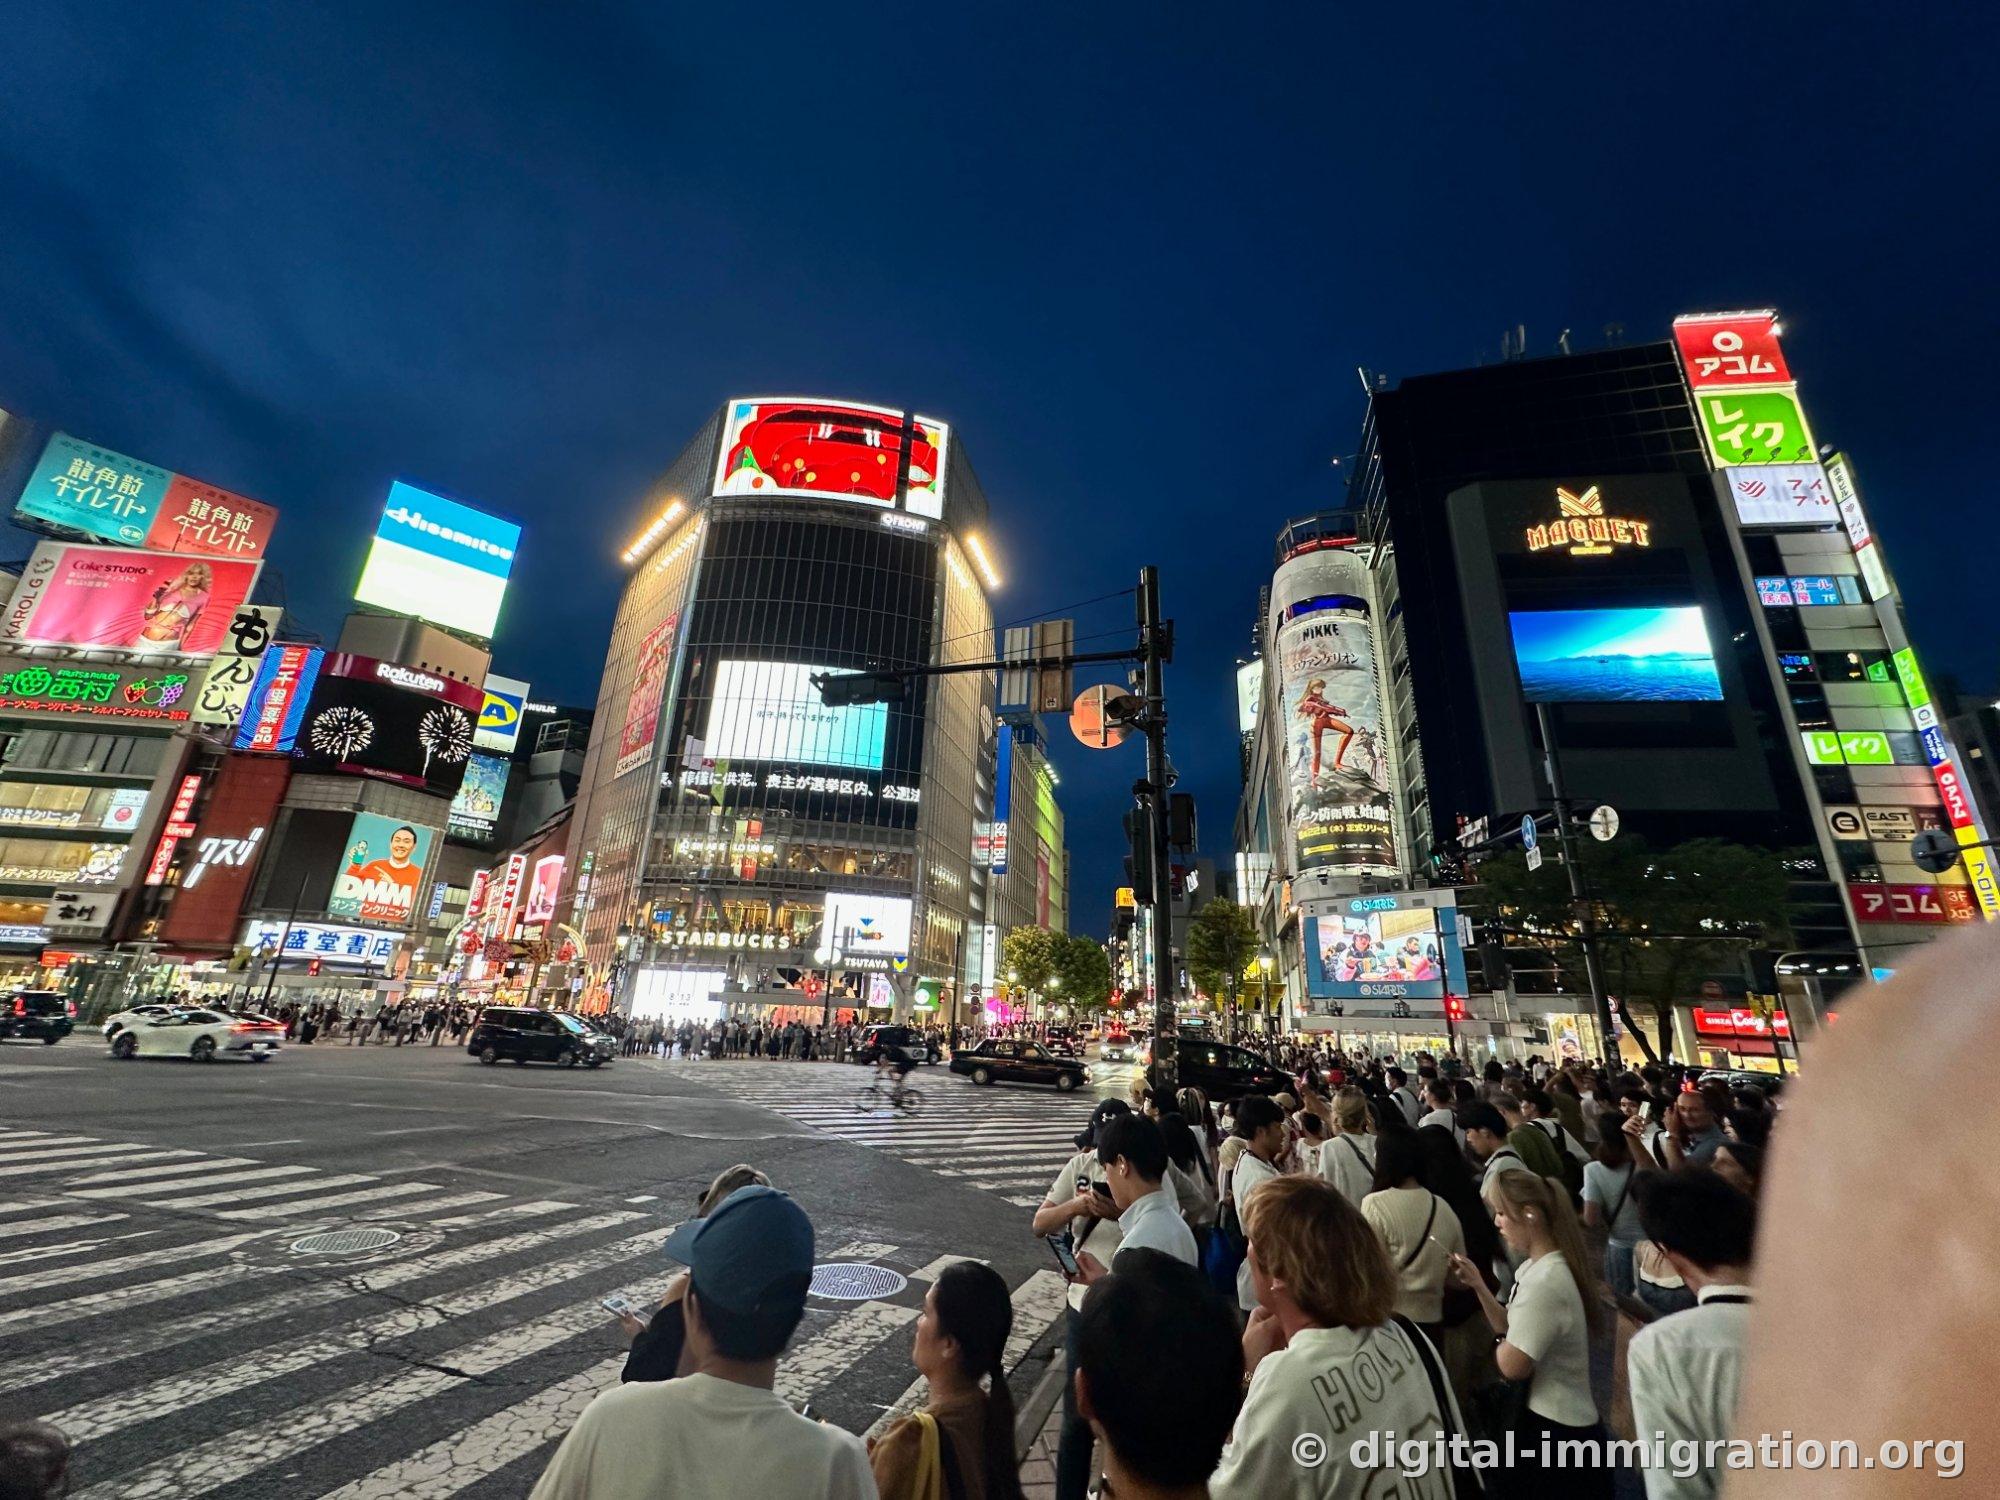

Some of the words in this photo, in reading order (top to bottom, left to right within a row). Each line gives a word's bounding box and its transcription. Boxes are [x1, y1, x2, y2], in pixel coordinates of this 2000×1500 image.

[1694, 354, 1777, 377] アコム
[67, 457, 145, 498] 龍角散
[50, 475, 147, 518] ダイレクト
[187, 497, 254, 534] 龍角散
[172, 515, 257, 553] ダイレクト
[1526, 518, 1651, 552] MAGNET
[73, 559, 103, 572] Coke
[104, 565, 147, 575] STUDIO
[2, 591, 39, 640] KAROL
[28, 577, 44, 590] G
[1302, 623, 1340, 641] NIKKE
[201, 608, 270, 722] もんじゃ
[377, 663, 446, 692] Rakuten
[48, 677, 117, 702] 西村
[252, 651, 303, 744] 三千里薬品
[1816, 737, 1881, 756] レイク
[1866, 812, 1910, 822] EAST
[183, 827, 265, 889] クスリ
[992, 821, 1008, 866] SEIBU
[334, 873, 413, 907] DMM
[1861, 893, 1943, 914] アコム
[1949, 890, 1968, 903] 3F
[331, 899, 411, 919] オンラインクリニック
[1363, 898, 1397, 912] STARTS
[661, 930, 791, 950] STARBUCKS
[844, 957, 889, 970] TSUTAYA
[1372, 984, 1407, 996] STARTS
[1310, 1324, 1416, 1435] HOLY
